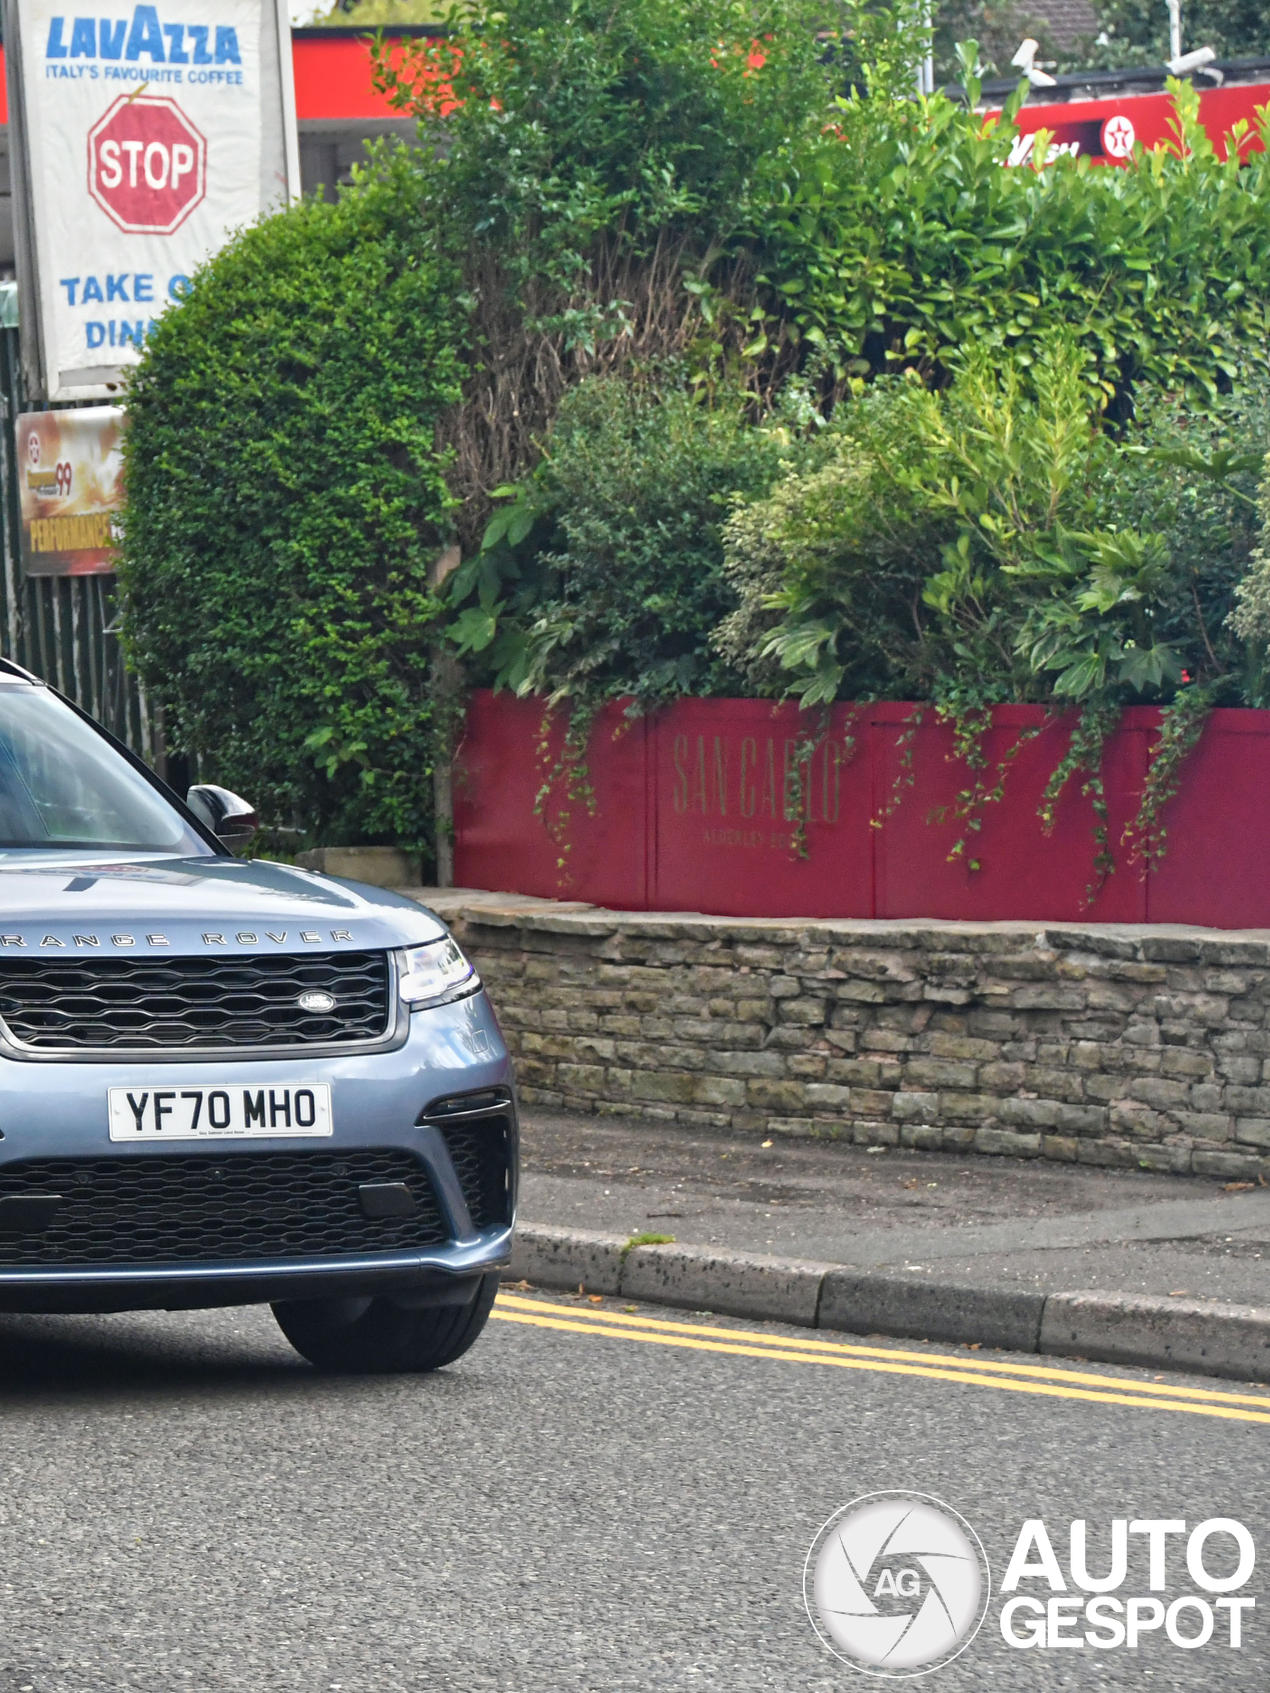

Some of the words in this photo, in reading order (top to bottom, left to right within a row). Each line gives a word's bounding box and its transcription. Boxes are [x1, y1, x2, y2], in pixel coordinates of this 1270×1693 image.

[45, 5, 242, 65] LAVAZZA
[46, 65, 99, 79] ITALY'S
[104, 66, 182, 83] FAVOURITE
[188, 70, 244, 85] COFFEE
[100, 140, 194, 190] STOP
[60, 273, 154, 306] TAKE
[85, 320, 157, 349] DIN
[56, 462, 72, 496] 99
[674, 734, 728, 816] SAN
[202, 929, 354, 946] ROVER
[126, 1090, 231, 1131] YF70
[244, 1089, 316, 1129] MHO
